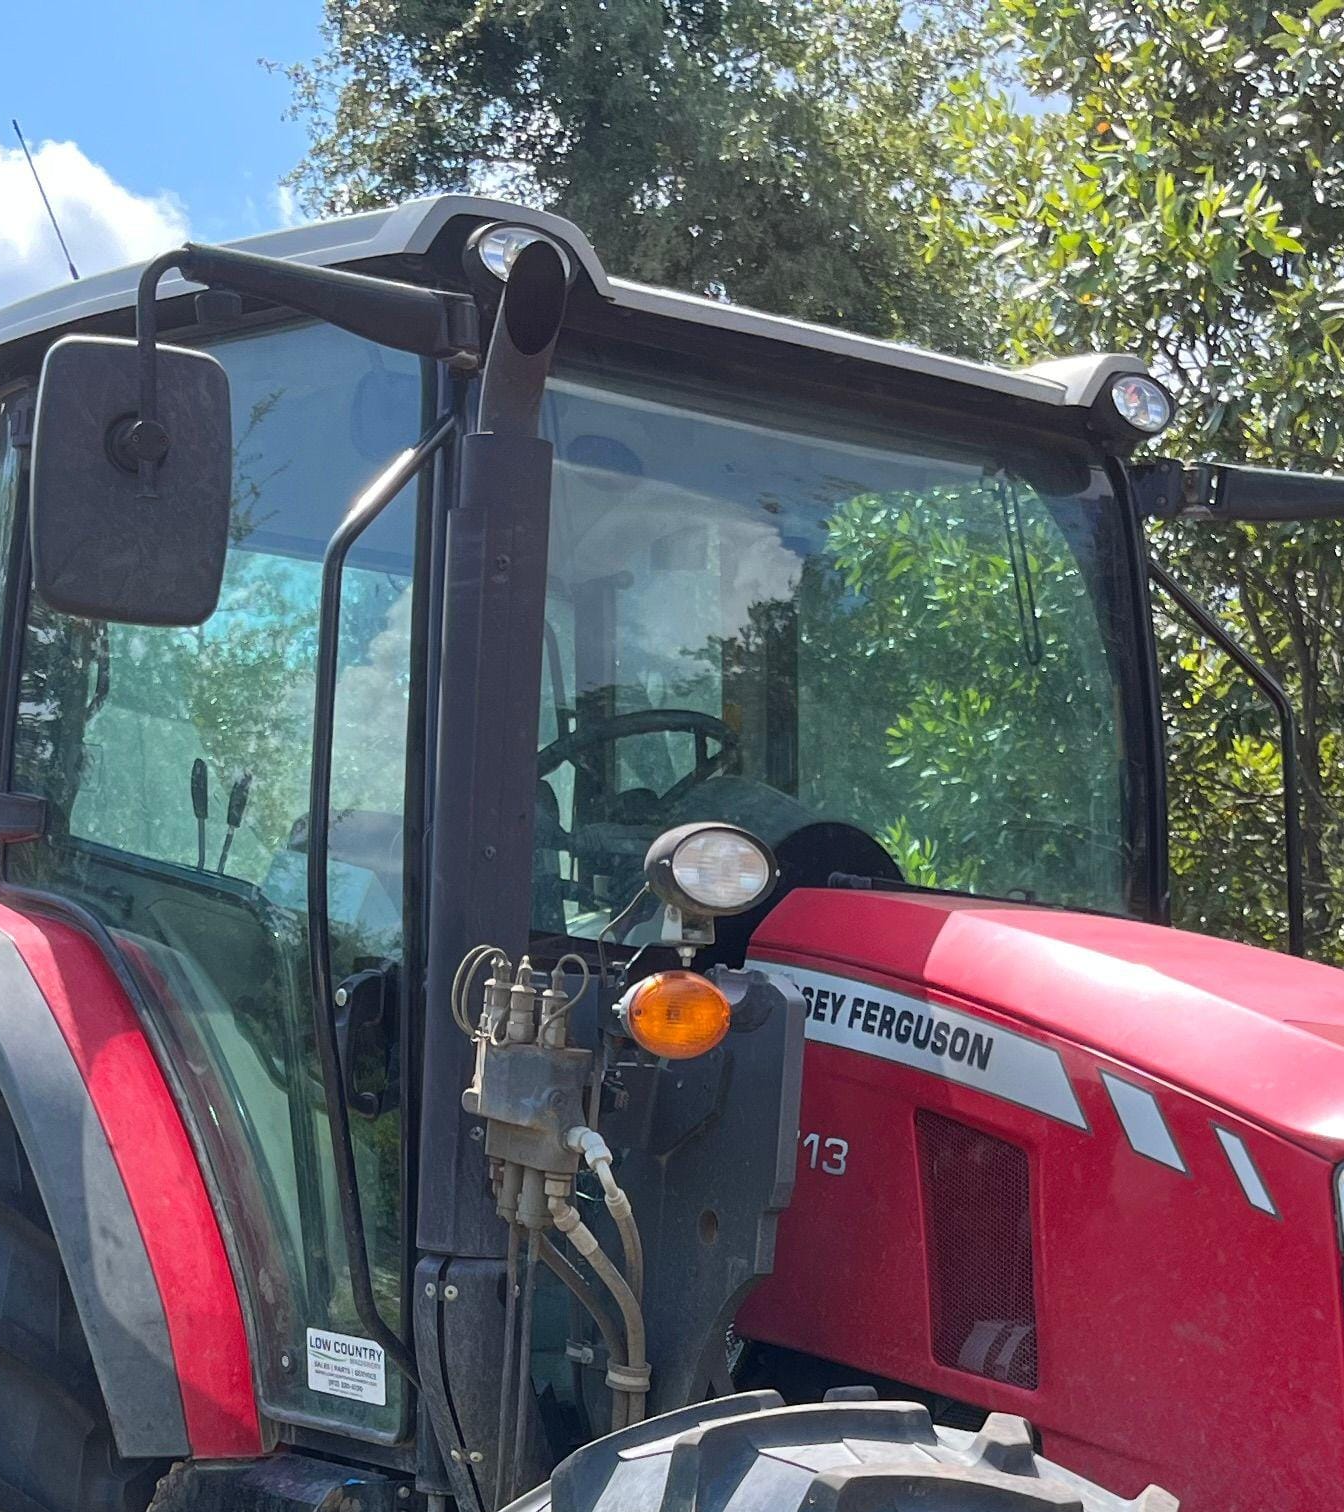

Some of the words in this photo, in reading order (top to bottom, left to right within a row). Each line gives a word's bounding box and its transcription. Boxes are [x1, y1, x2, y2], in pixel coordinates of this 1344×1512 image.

[794, 984, 846, 1025] SEY
[847, 998, 994, 1072] FERGUSON
[797, 1130, 849, 1176] 13
[309, 1335, 332, 1352] LOW
[333, 1341, 383, 1363] COUNTRY
